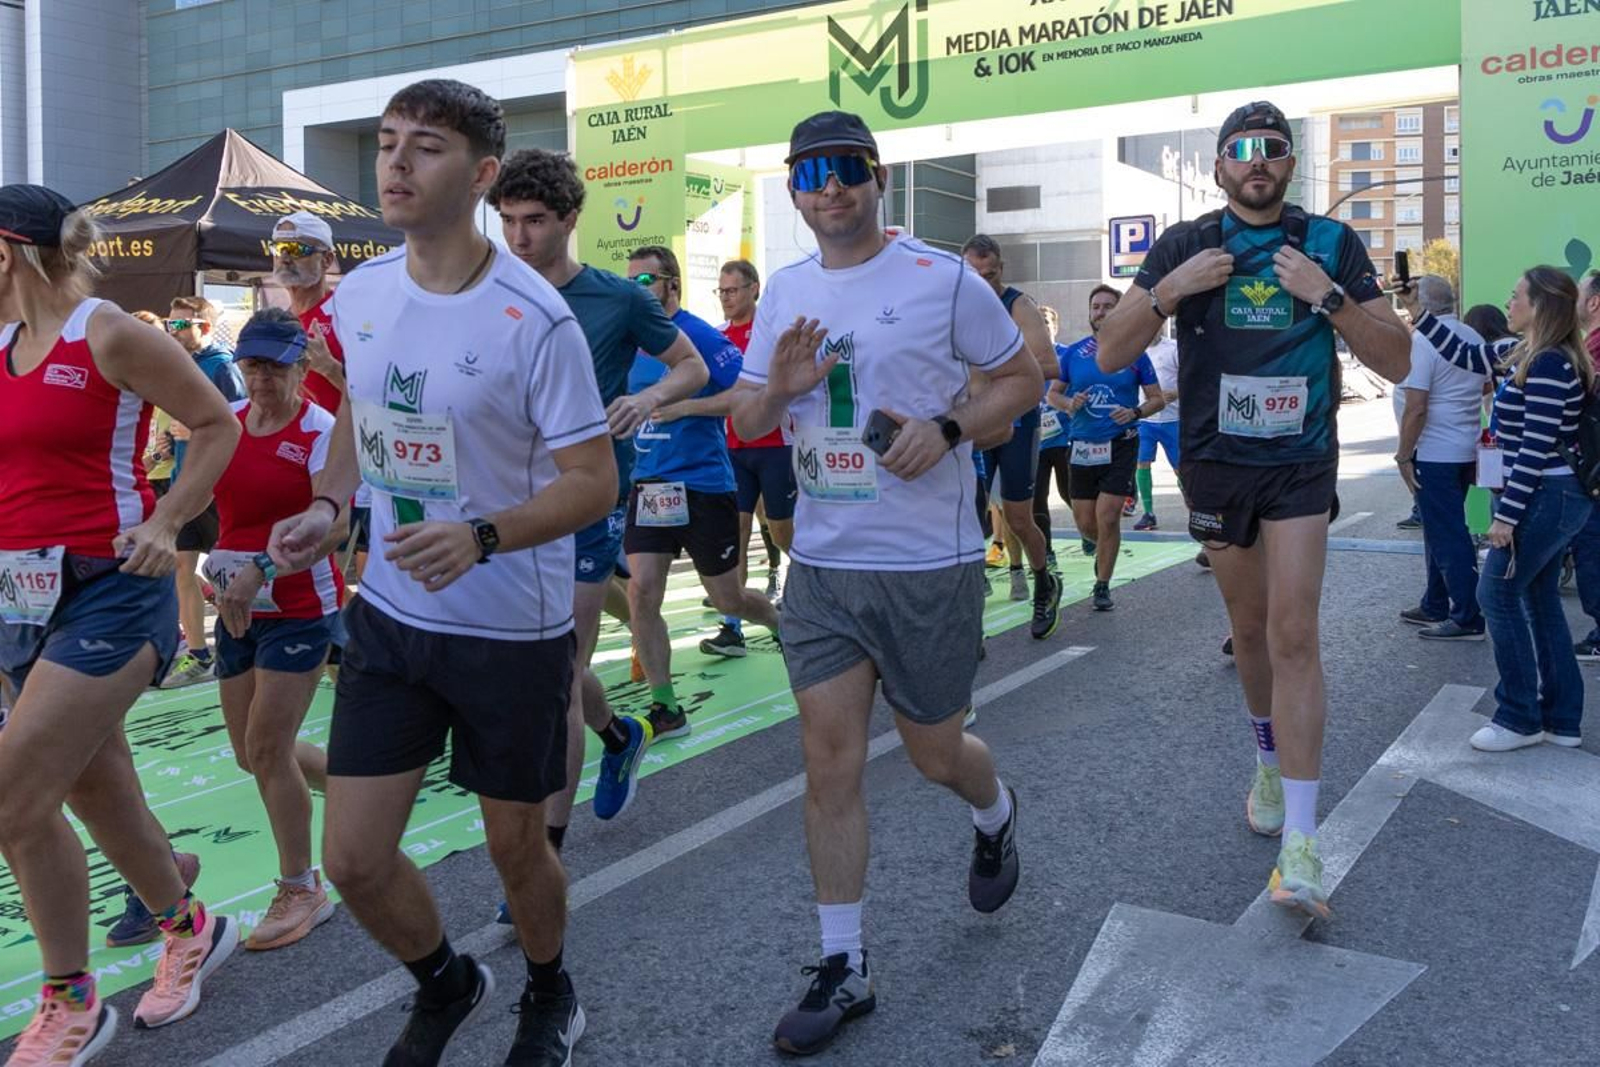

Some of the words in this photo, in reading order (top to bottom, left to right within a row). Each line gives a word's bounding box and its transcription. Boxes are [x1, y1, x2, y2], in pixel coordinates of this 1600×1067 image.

[946, 29, 1013, 56] MEDIA
[1018, 7, 1128, 46] MARATÓN
[1138, 4, 1168, 29] DE
[974, 57, 992, 78] &
[1042, 53, 1054, 62] EN
[1056, 46, 1099, 60] MEMORIA
[1101, 44, 1114, 54] DE
[1116, 40, 1141, 52] PACO
[1143, 31, 1203, 48] MANZANEDA
[1517, 74, 1553, 84] obras
[587, 110, 621, 127] CAJA
[624, 103, 673, 123] RURAL
[611, 125, 647, 145] JAÉN
[584, 157, 673, 181] calderón
[1531, 171, 1556, 187] de
[596, 235, 666, 251] Ayuntamiento
[1119, 223, 1145, 254] P
[1265, 395, 1299, 411] 978
[394, 440, 442, 463] 973
[825, 452, 864, 469] 950
[15, 572, 58, 590] 1167
